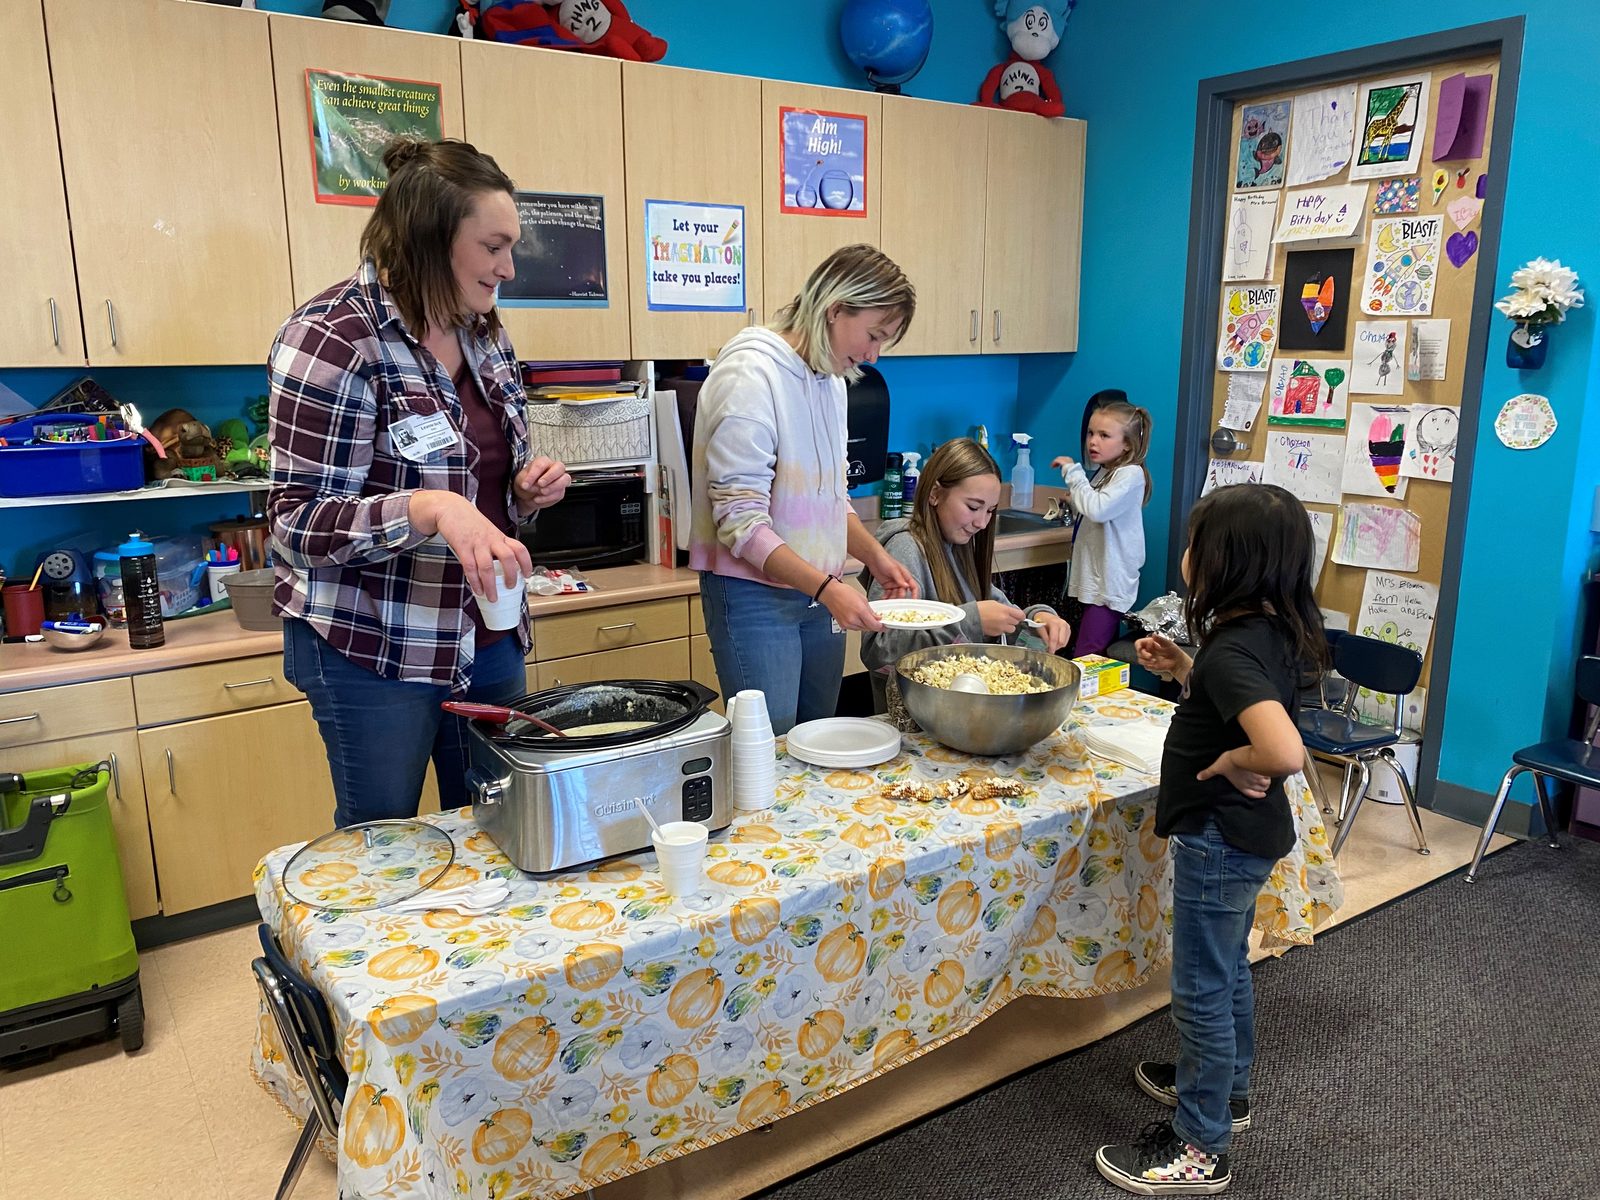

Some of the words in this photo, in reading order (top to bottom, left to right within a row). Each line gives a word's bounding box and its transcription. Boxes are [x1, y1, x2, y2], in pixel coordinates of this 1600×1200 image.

[571, 0, 600, 32] THING
[586, 16, 602, 32] 2
[1002, 69, 1035, 86] THING
[317, 79, 340, 92] Even
[342, 80, 357, 94] the
[358, 83, 396, 99] smallest
[396, 89, 436, 102] creatures
[322, 96, 340, 106] can
[342, 95, 377, 109] achieve
[377, 101, 401, 114] great
[403, 102, 430, 118] things
[811, 118, 838, 135] Aim
[807, 137, 842, 156] High!
[338, 174, 350, 191] by
[353, 176, 389, 189] workin
[672, 219, 690, 232] Let
[693, 223, 719, 236] your
[1402, 220, 1436, 240] BLAST
[652, 237, 742, 266] IMAGINATION
[653, 270, 678, 282] take
[681, 274, 701, 286] you
[704, 272, 741, 287] places!
[1248, 289, 1275, 305] BLAST
[1376, 576, 1395, 588] Mrs
[1372, 593, 1398, 604] from
